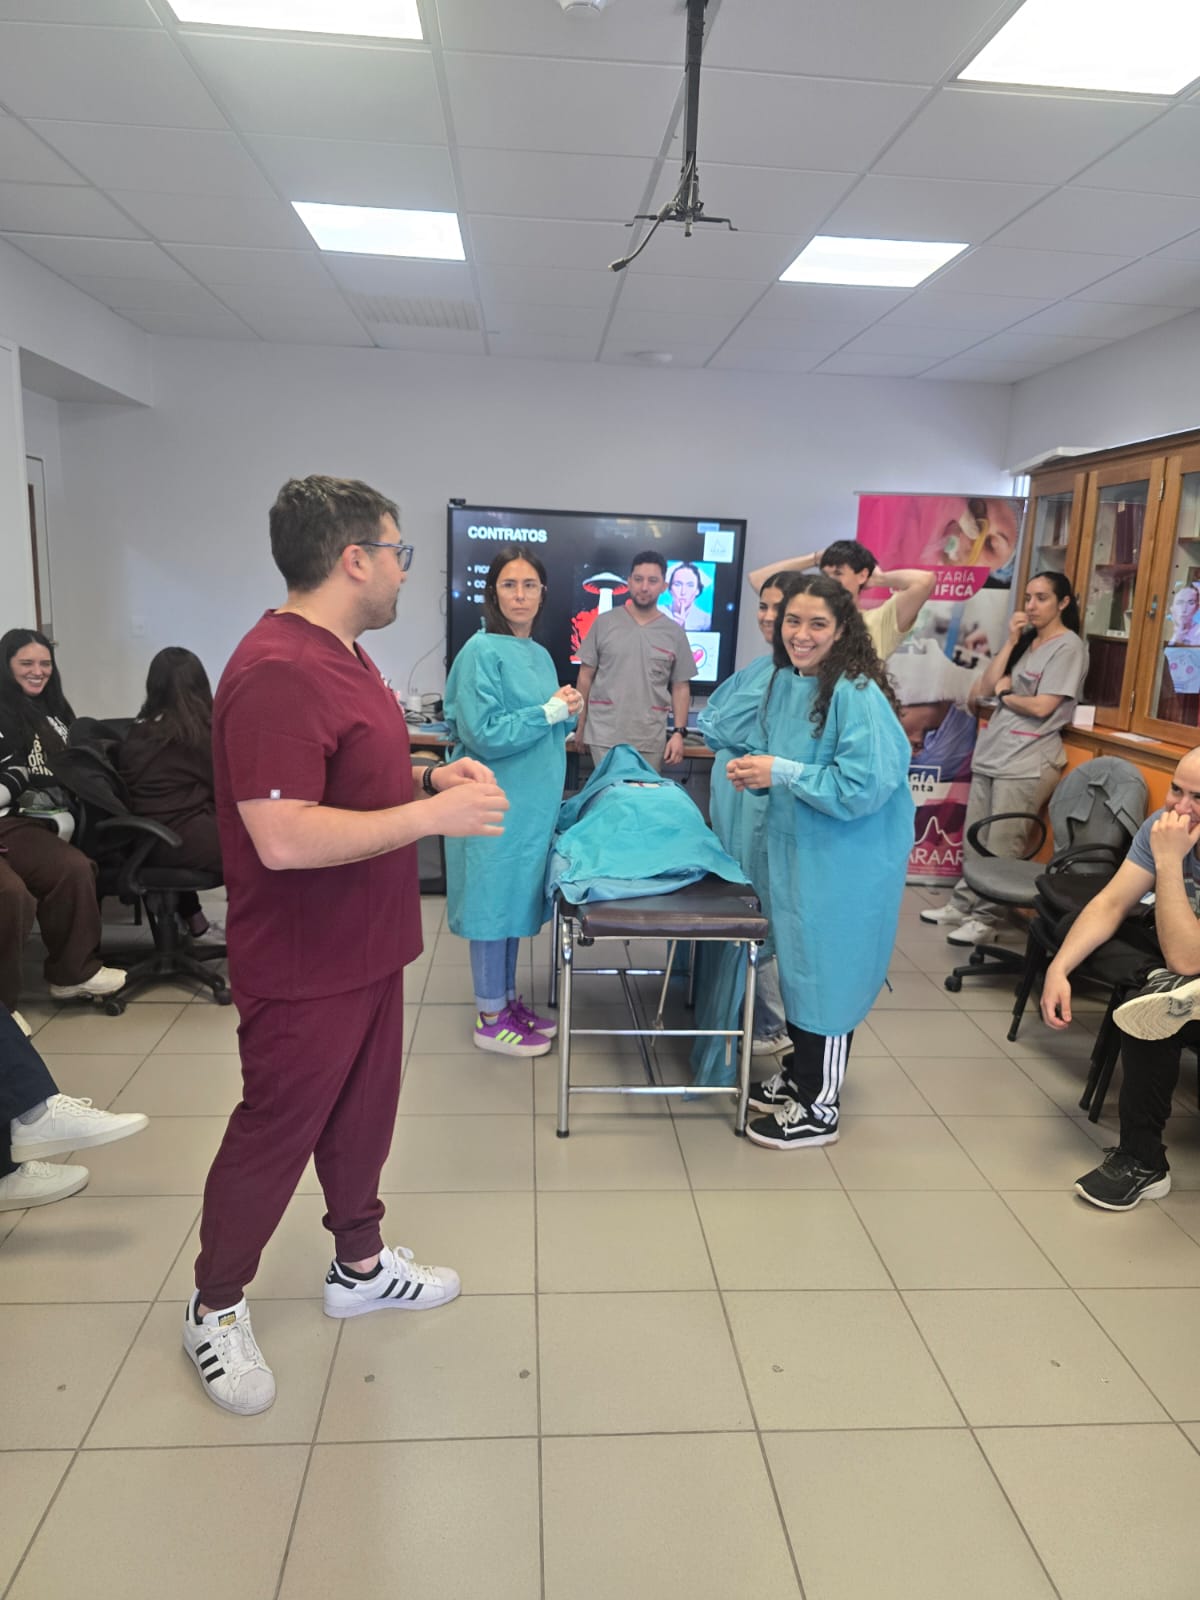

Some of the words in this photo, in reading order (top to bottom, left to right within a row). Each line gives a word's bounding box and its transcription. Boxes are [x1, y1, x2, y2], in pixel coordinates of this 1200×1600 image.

[467, 525, 548, 543] CONTRATOS
[937, 569, 975, 583] TARÍA
[934, 584, 973, 597] IFICA
[909, 770, 935, 784] GÍA
[911, 784, 934, 793] nta
